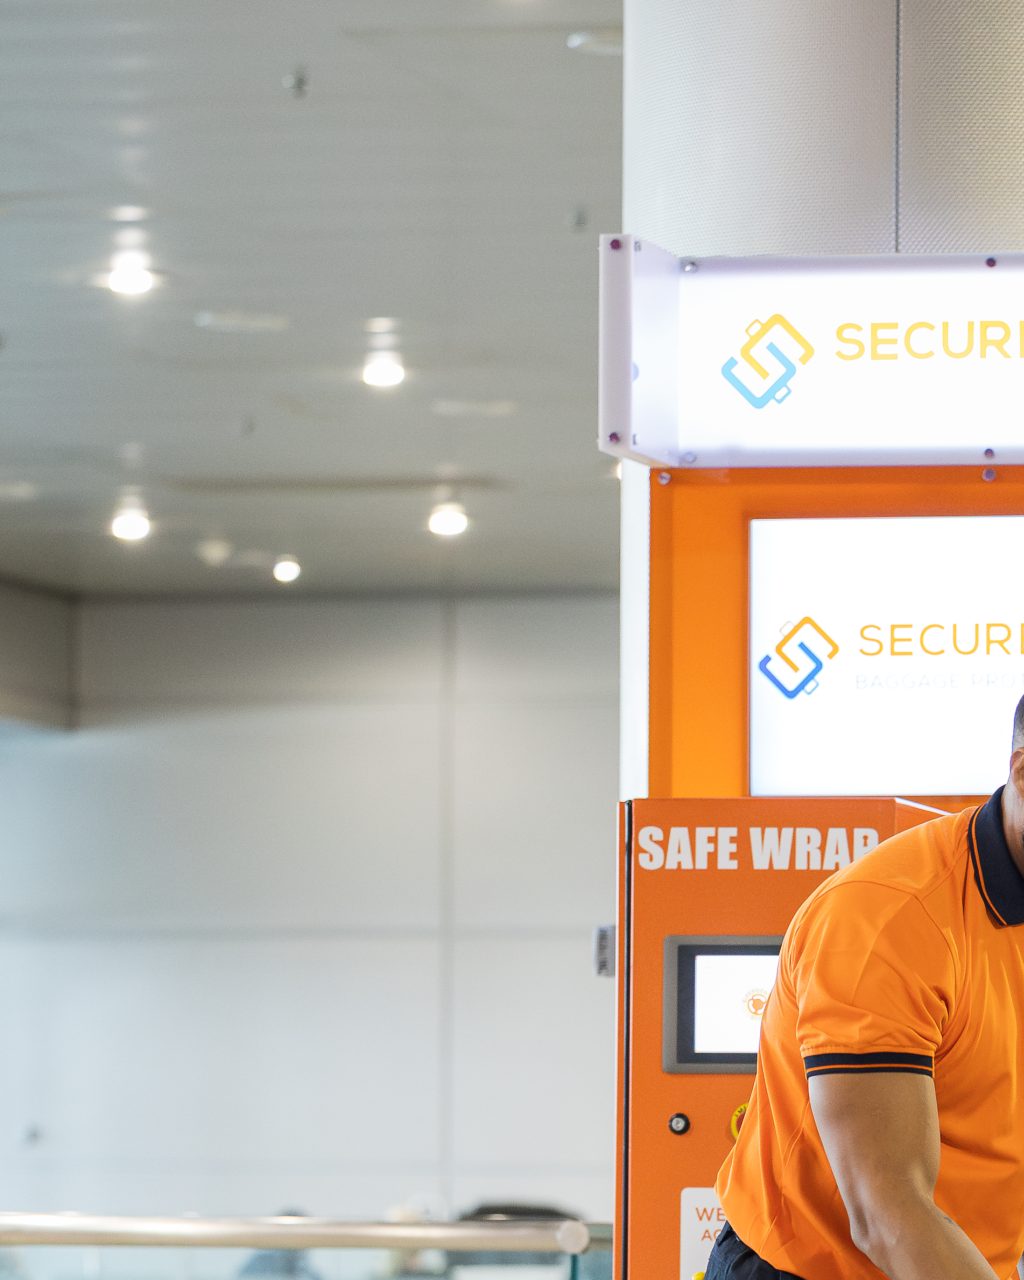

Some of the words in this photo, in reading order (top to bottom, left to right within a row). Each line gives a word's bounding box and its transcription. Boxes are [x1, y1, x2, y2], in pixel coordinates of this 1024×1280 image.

[854, 672, 960, 690] BAGGAGE
[637, 826, 738, 871] SAFE
[749, 826, 880, 871] WRAP
